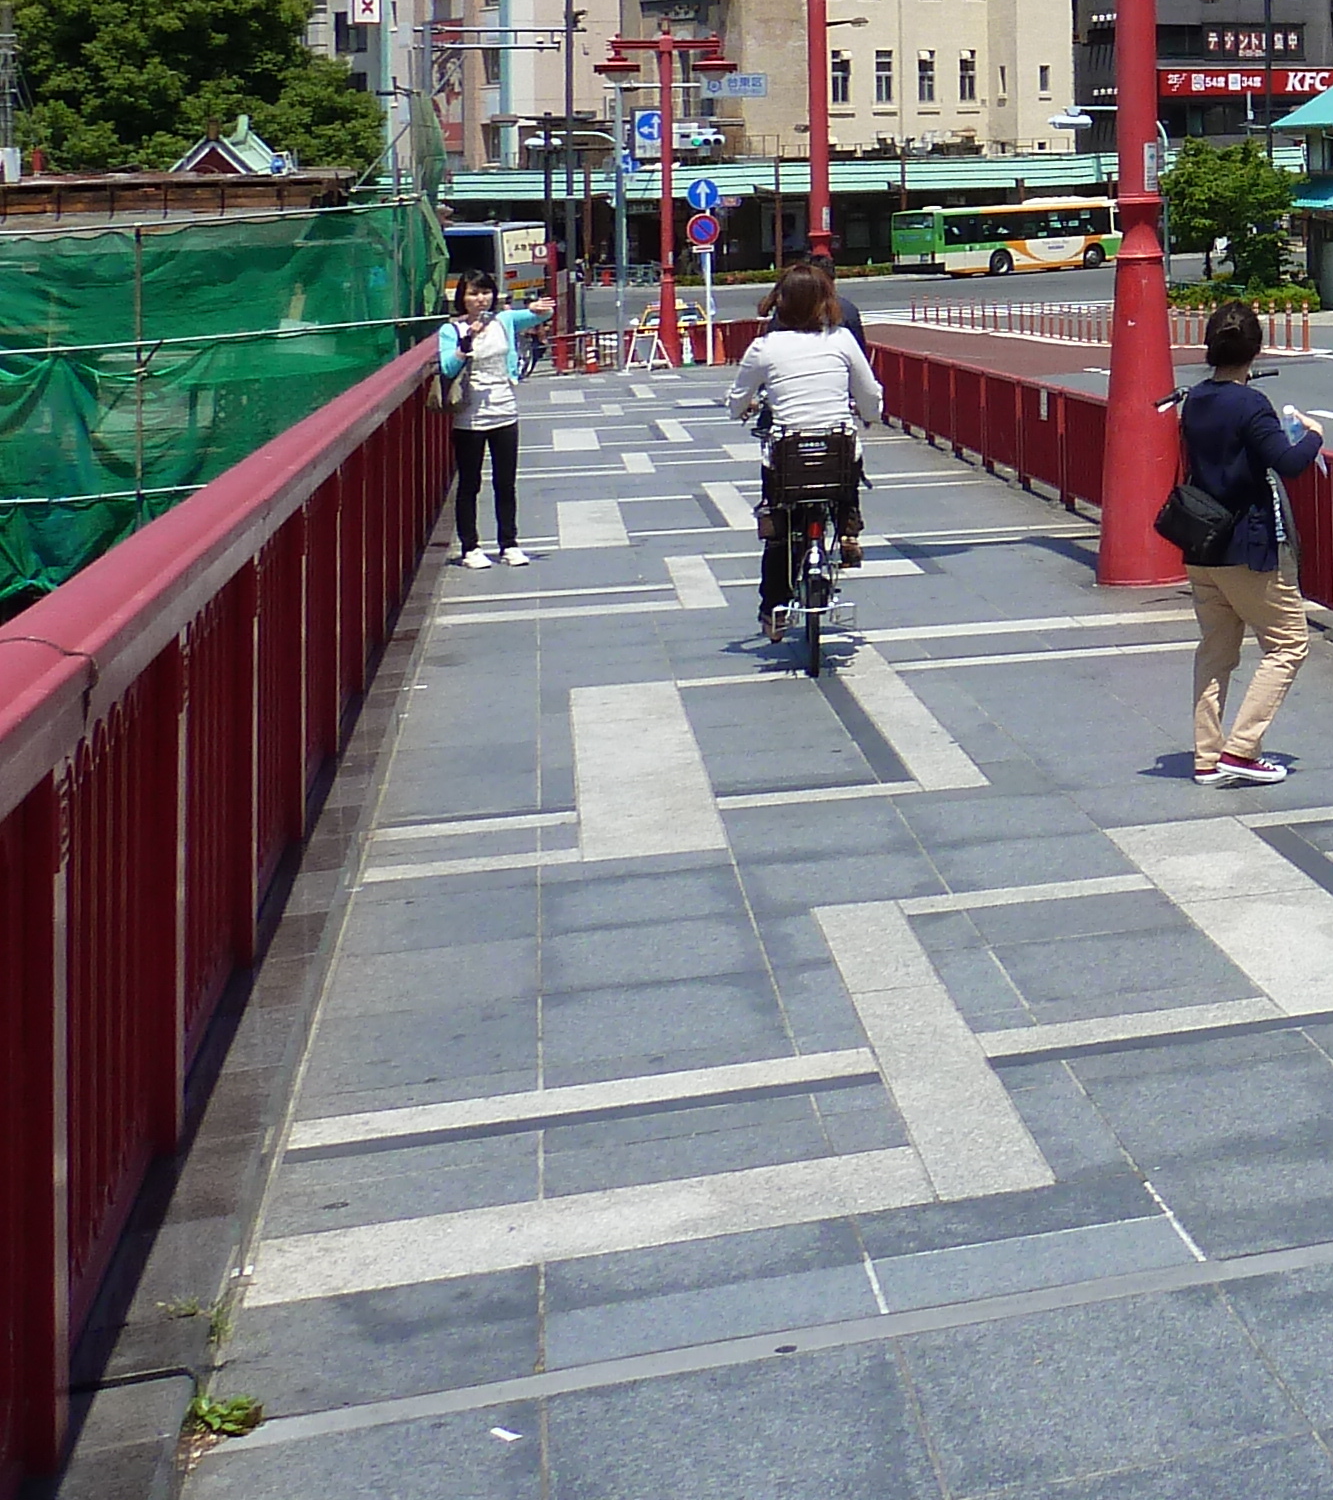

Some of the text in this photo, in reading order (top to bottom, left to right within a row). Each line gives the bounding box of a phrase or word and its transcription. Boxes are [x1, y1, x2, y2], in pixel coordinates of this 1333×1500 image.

[1207, 31, 1298, 50] テナント集中
[1285, 71, 1331, 92] KFC
